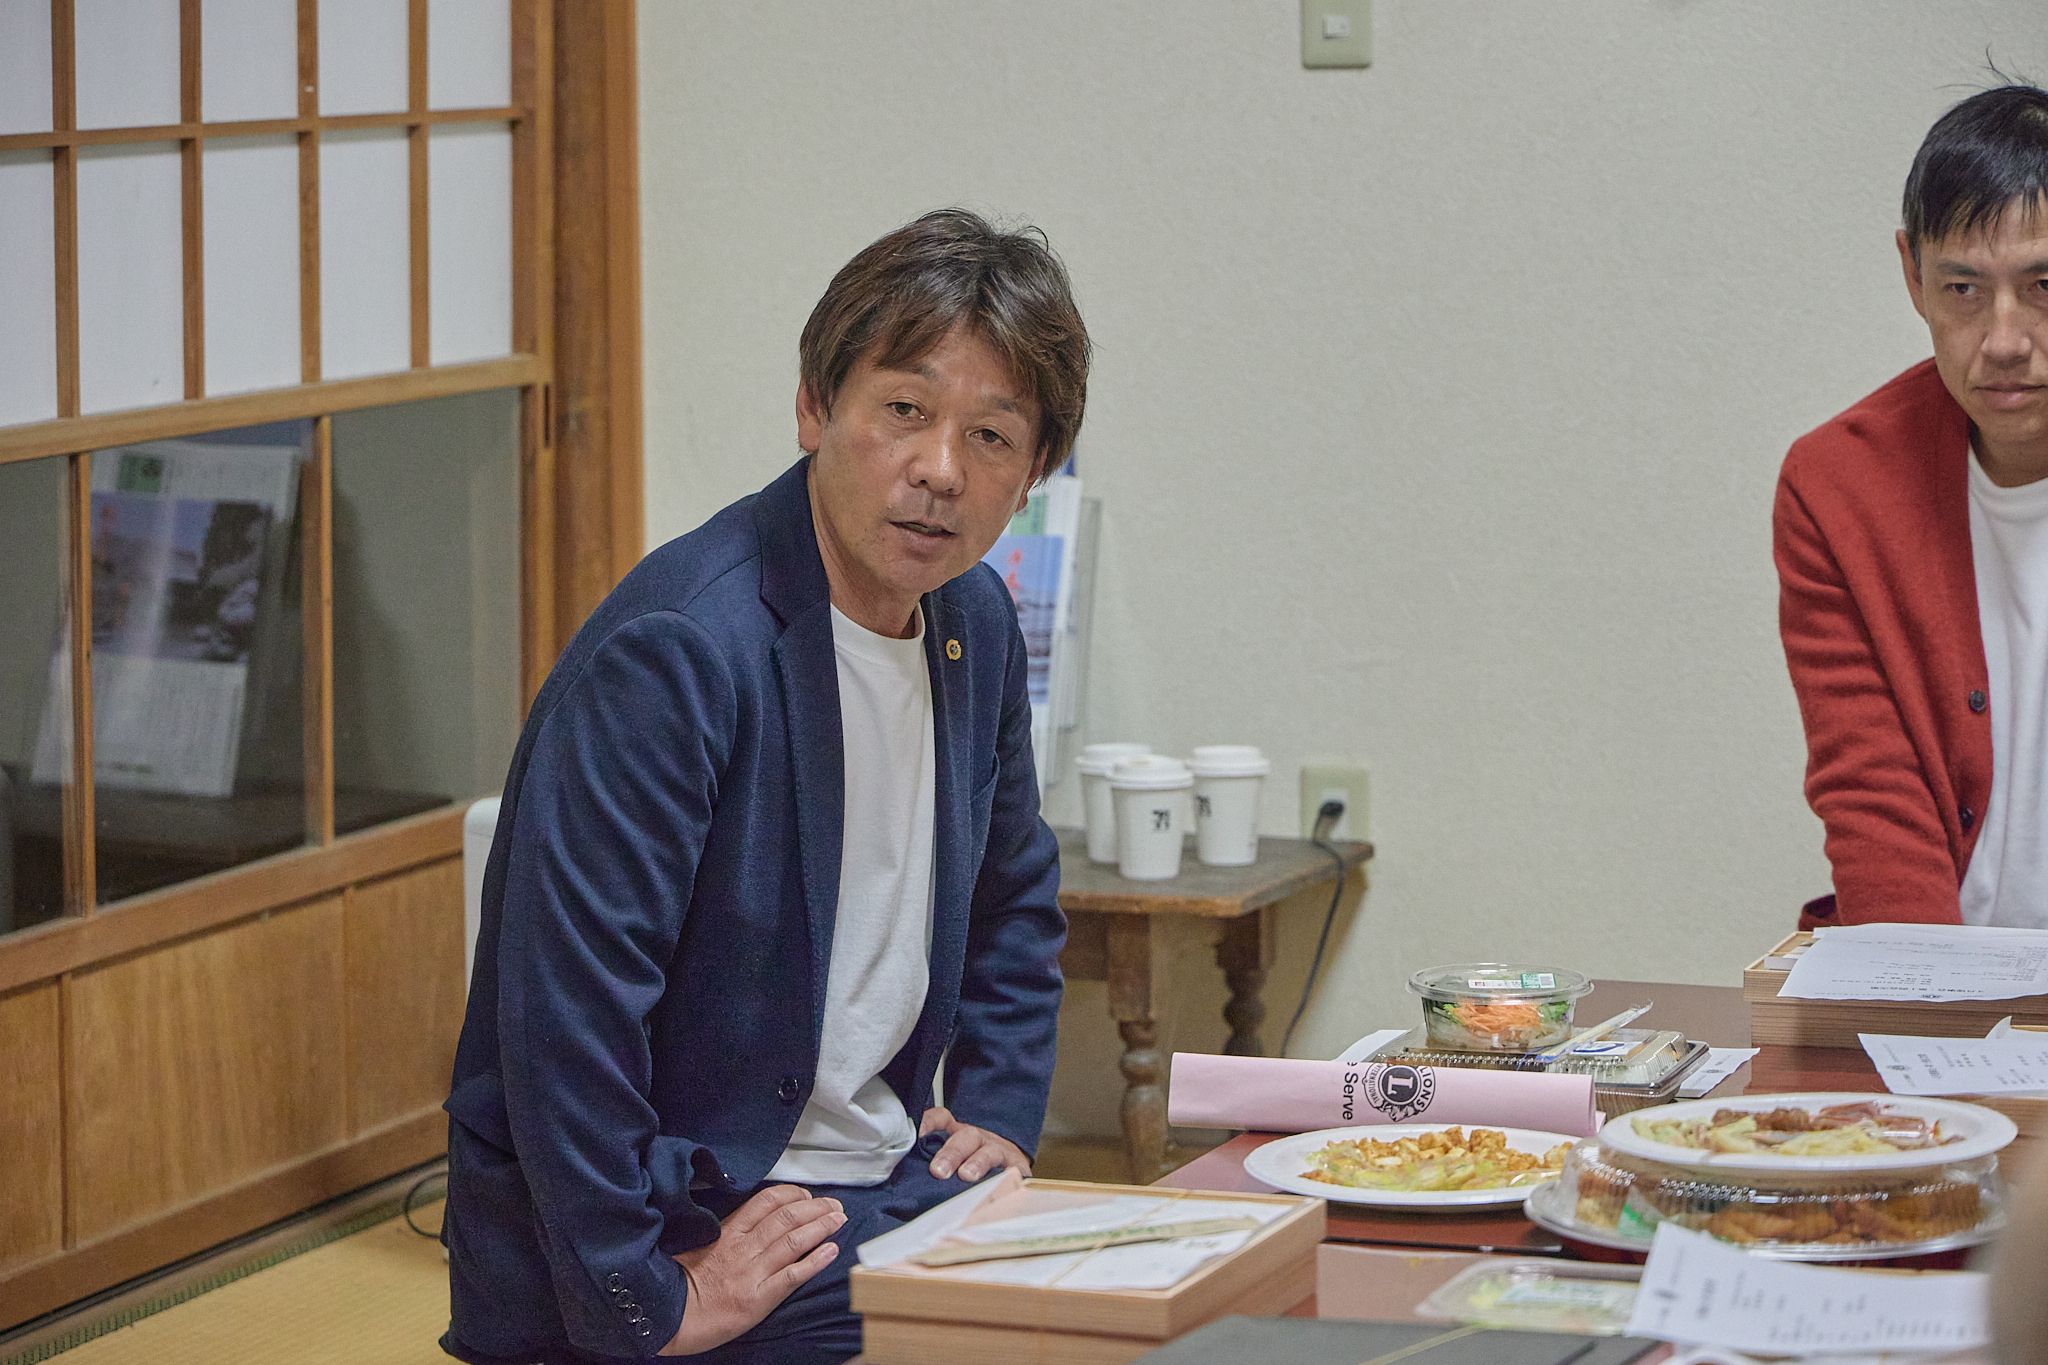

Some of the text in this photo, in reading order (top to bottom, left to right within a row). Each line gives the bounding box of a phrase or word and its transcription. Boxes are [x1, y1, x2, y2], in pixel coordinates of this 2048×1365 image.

[1342, 1072, 1359, 1120] Serve
[1387, 1074, 1414, 1095] L
[1416, 1066, 1433, 1108] LIONS
